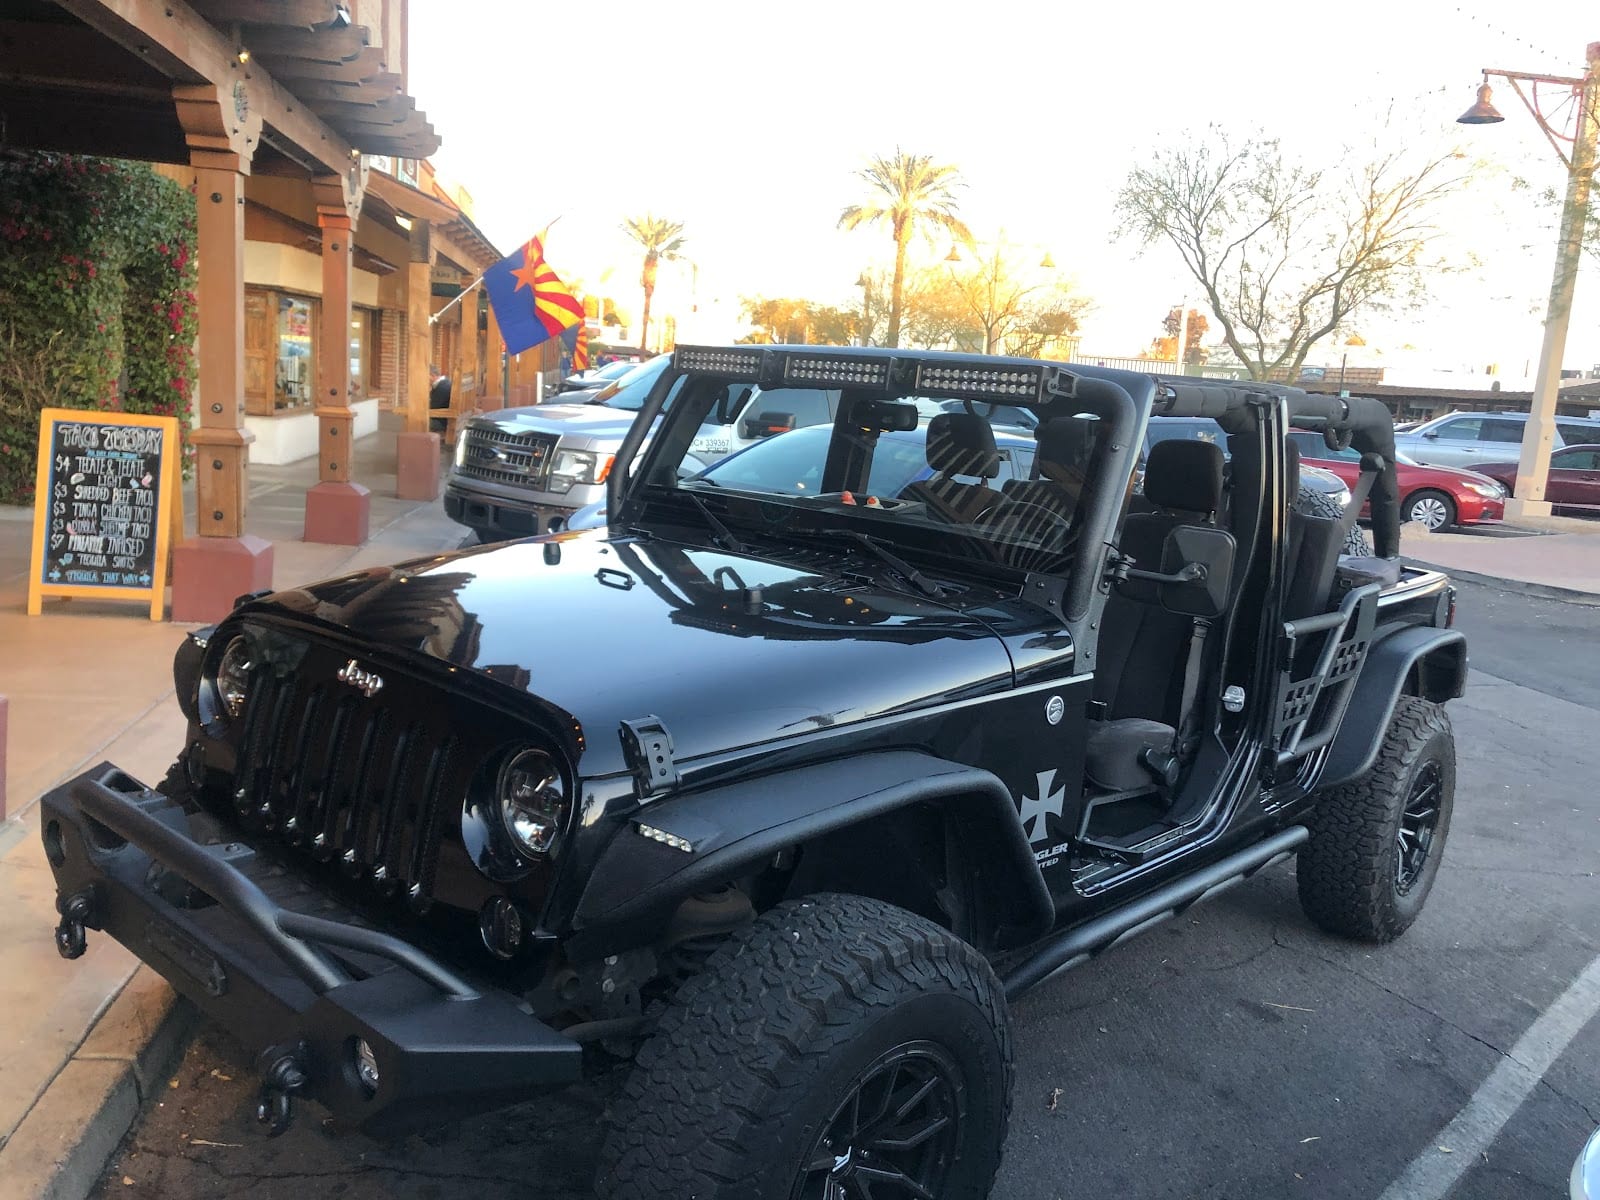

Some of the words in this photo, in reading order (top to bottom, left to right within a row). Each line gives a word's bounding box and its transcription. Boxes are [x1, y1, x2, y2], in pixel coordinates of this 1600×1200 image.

[58, 424, 99, 448] TACO
[100, 427, 162, 455] TUESDAY
[705, 439, 730, 447] 339367
[56, 453, 71, 473] $4
[75, 456, 106, 475] TECATE
[116, 459, 145, 478] TECATE
[97, 475, 122, 488] LIGHT
[54, 481, 68, 500] $3
[112, 487, 133, 504] BEEF
[134, 488, 154, 507] TACO
[53, 501, 66, 517] $3
[72, 502, 98, 518] TINGA
[100, 503, 132, 522] CHICKEN
[132, 506, 152, 524] TACO
[130, 522, 150, 539] TACO
[50, 532, 65, 550] $7
[77, 553, 107, 568] TEQUILA
[337, 659, 384, 698] Jeep
